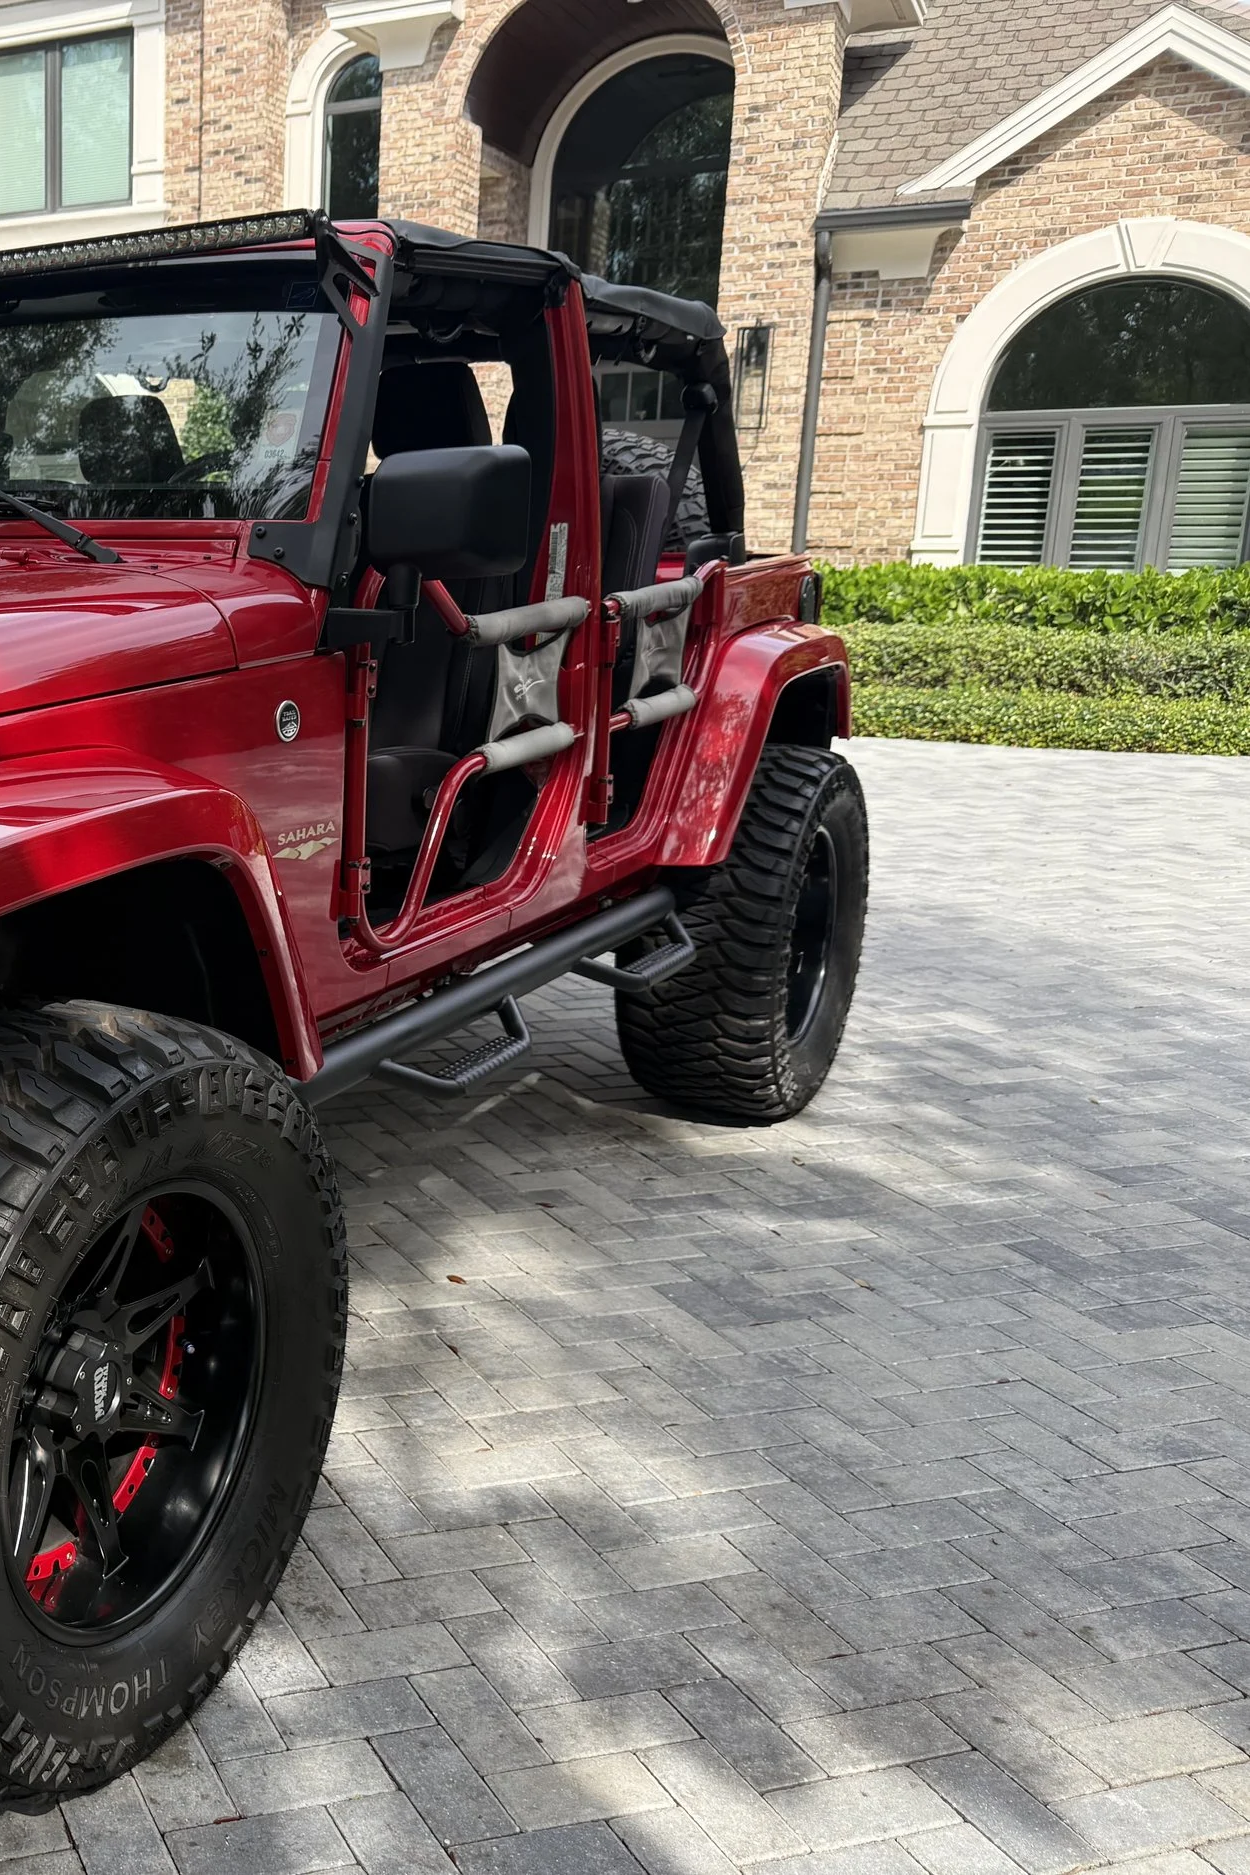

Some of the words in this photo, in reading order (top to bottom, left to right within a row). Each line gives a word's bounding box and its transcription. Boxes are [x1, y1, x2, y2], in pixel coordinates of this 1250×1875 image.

[277, 820, 335, 846] SAHARA
[94, 1367, 104, 1420] MOTO
[193, 1479, 288, 1665] MICKEY
[9, 1642, 172, 1719] THOMPSON
